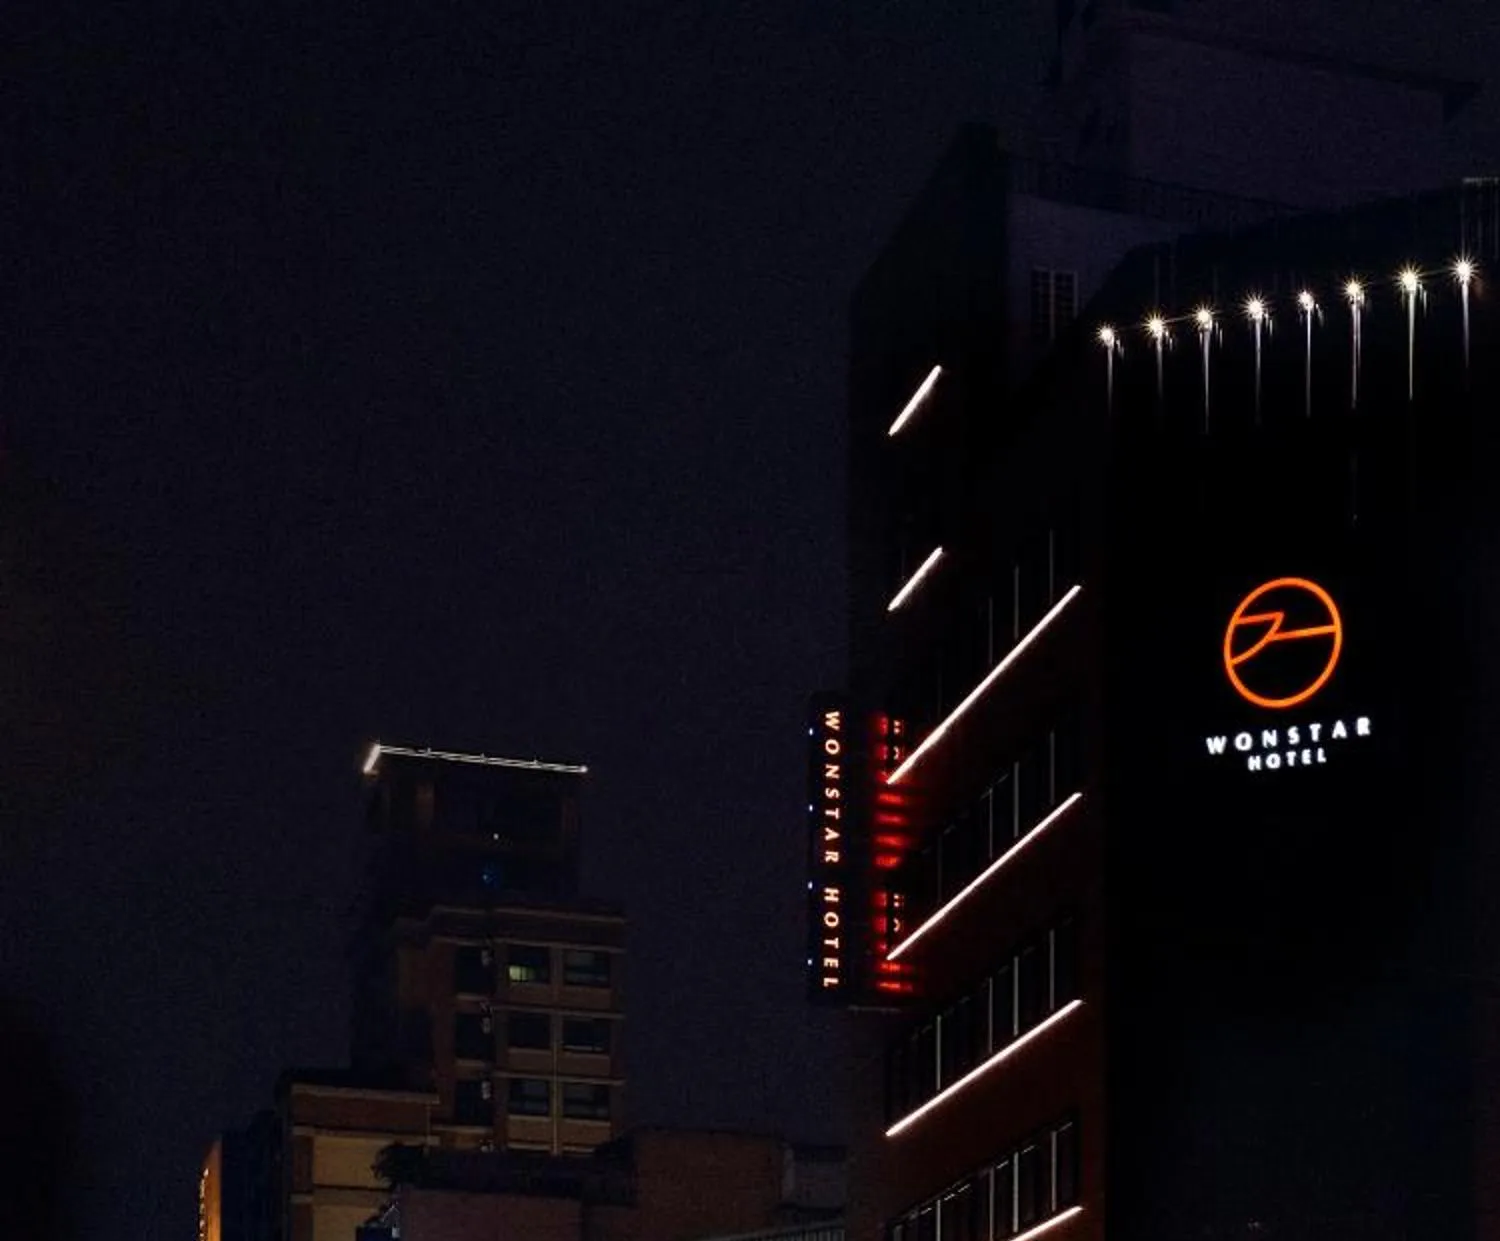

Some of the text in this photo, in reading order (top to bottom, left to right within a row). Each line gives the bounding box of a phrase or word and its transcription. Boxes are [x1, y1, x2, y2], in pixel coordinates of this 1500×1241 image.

[1206, 716, 1371, 755] WONSTAR
[1247, 747, 1327, 771] HOTEL
[823, 711, 841, 987] WONSTAR HOTEL
